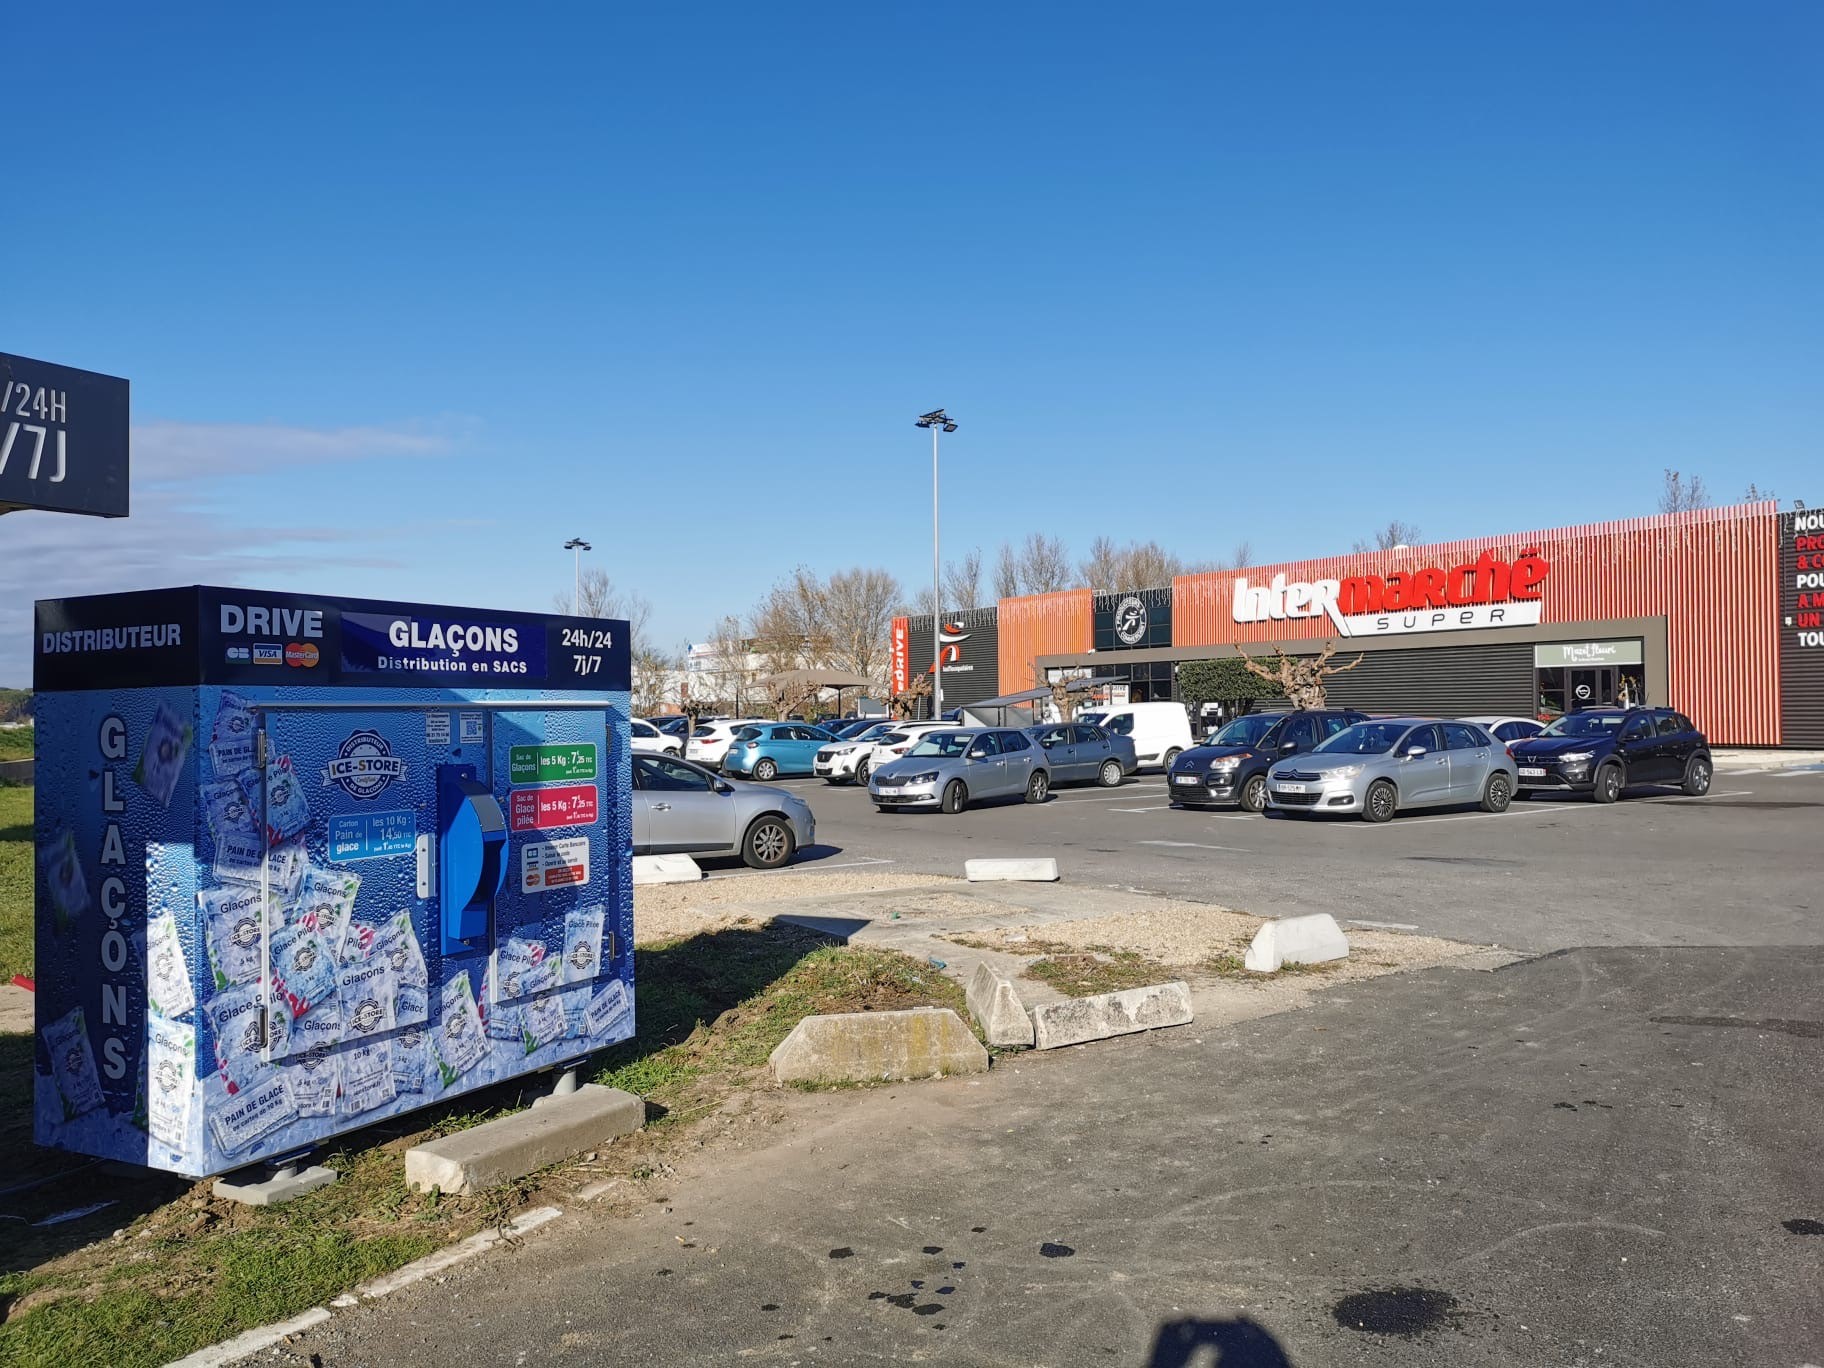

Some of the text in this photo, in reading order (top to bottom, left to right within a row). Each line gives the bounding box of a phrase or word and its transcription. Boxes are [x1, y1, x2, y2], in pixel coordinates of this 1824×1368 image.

[220, 604, 323, 638] DRIVE
[1377, 608, 1505, 631] SUPER
[1797, 612, 1820, 627] UN
[43, 623, 181, 654] DISTRIBUTEUR
[389, 620, 519, 657] GLAÇONS
[561, 628, 612, 649] 24h/24
[258, 649, 278, 658] VISA
[285, 649, 319, 660] MasterCard
[378, 656, 527, 673] Distribution en SACS
[573, 654, 602, 675] 7j/7
[346, 736, 385, 752] DISTRIBUTEUR
[331, 759, 399, 776] ICE-STORE
[511, 763, 536, 773] Glaçons
[540, 757, 551, 766] les
[551, 755, 557, 765] 5
[557, 755, 567, 766] Kg
[515, 804, 534, 813] Glace
[540, 802, 551, 811] les
[552, 801, 557, 810] 5
[557, 800, 567, 811] Kg
[338, 820, 358, 828] Carton
[372, 815, 407, 827] les 10 Kg
[517, 814, 534, 828] pilée
[335, 829, 353, 840] Pain
[227, 845, 245, 856] PAIN
[246, 849, 256, 858] DE
[336, 842, 359, 855] glace
[100, 717, 127, 1080] GLAÇONS
[314, 882, 347, 898] Glaçons
[220, 895, 262, 914] Glaçons
[274, 937, 297, 955] Glace
[376, 928, 405, 951] Glaçons
[500, 950, 520, 962] Glace
[342, 966, 385, 986] Glaçons
[530, 970, 556, 988] Glaçons
[219, 1002, 253, 1022] Glace
[433, 991, 464, 1016] Glaçons
[155, 1033, 189, 1056] Glaçons
[224, 1084, 284, 1126] PAIN DE GLACE
[240, 1113, 259, 1127] carton
